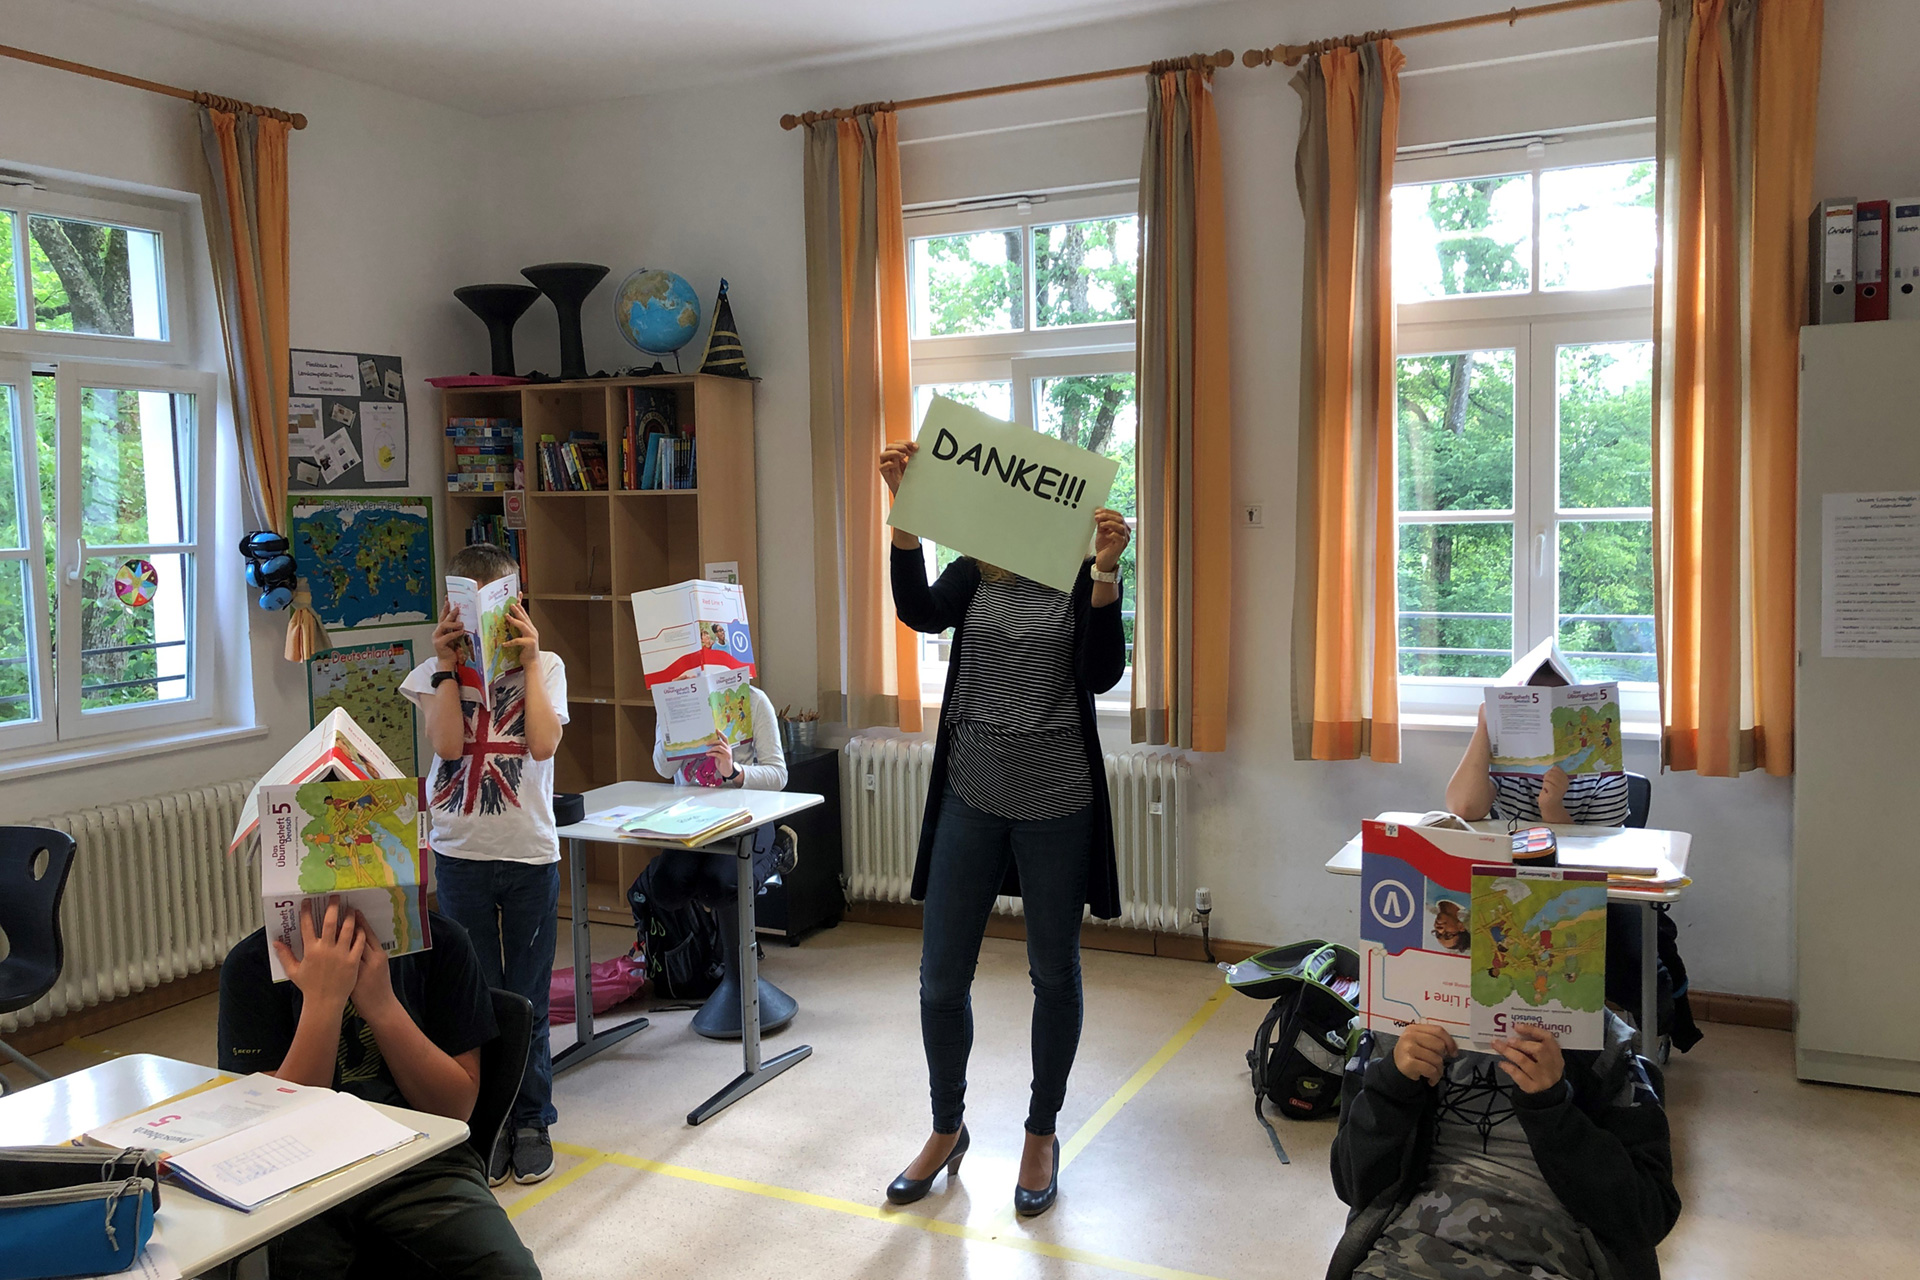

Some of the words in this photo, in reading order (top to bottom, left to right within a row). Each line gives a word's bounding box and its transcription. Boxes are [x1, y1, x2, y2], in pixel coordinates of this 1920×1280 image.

[931, 427, 1086, 509] DANKE!!!
[323, 500, 338, 511] Die
[340, 499, 361, 511] Welt
[363, 500, 376, 510] der
[381, 500, 401, 510] Tiere
[503, 583, 509, 596] 5
[331, 643, 393, 664] Deutschland
[736, 672, 742, 682] 5
[690, 683, 697, 693] 5
[1532, 693, 1539, 704] 5
[1600, 689, 1608, 700] 5
[272, 803, 291, 814] 5
[276, 817, 287, 867] Übungsheft
[275, 900, 294, 908] 5
[1424, 990, 1430, 1001] 1
[1433, 992, 1461, 1007] Line
[1493, 1012, 1507, 1033] 5
[1511, 1014, 1543, 1024] Deutsch
[147, 1114, 181, 1128] 5
